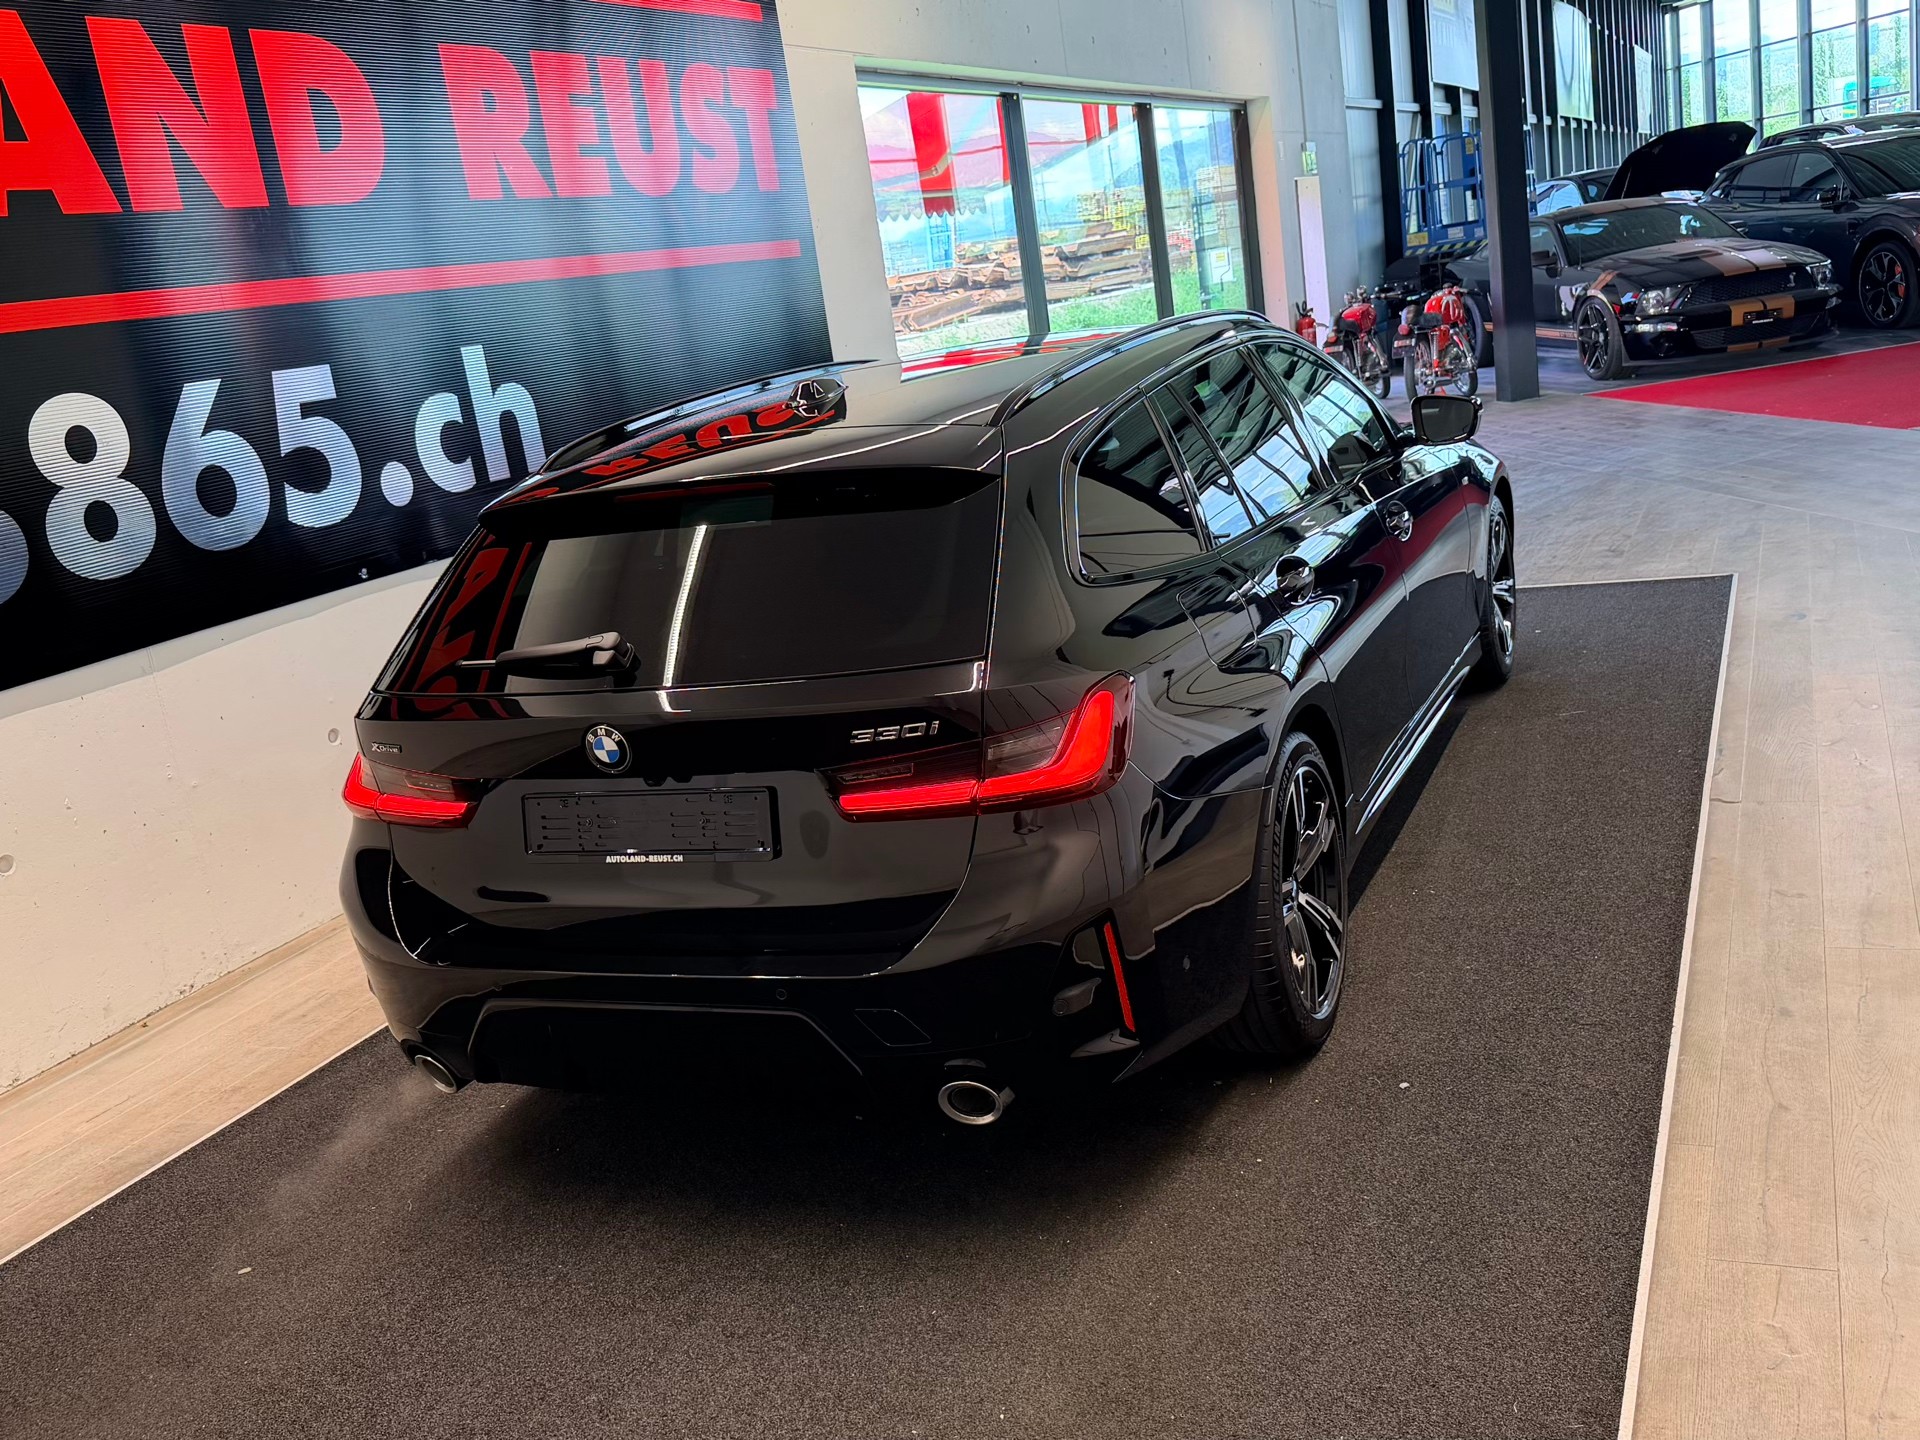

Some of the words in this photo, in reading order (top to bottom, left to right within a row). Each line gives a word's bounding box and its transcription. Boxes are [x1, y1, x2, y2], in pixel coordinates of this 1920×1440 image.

[438, 43, 780, 200] REUST
[0, 344, 546, 601] 865.ch
[587, 728, 621, 743] BMW
[850, 720, 940, 744] 330i
[605, 854, 684, 864] AUTOLAND-REUST.CH
